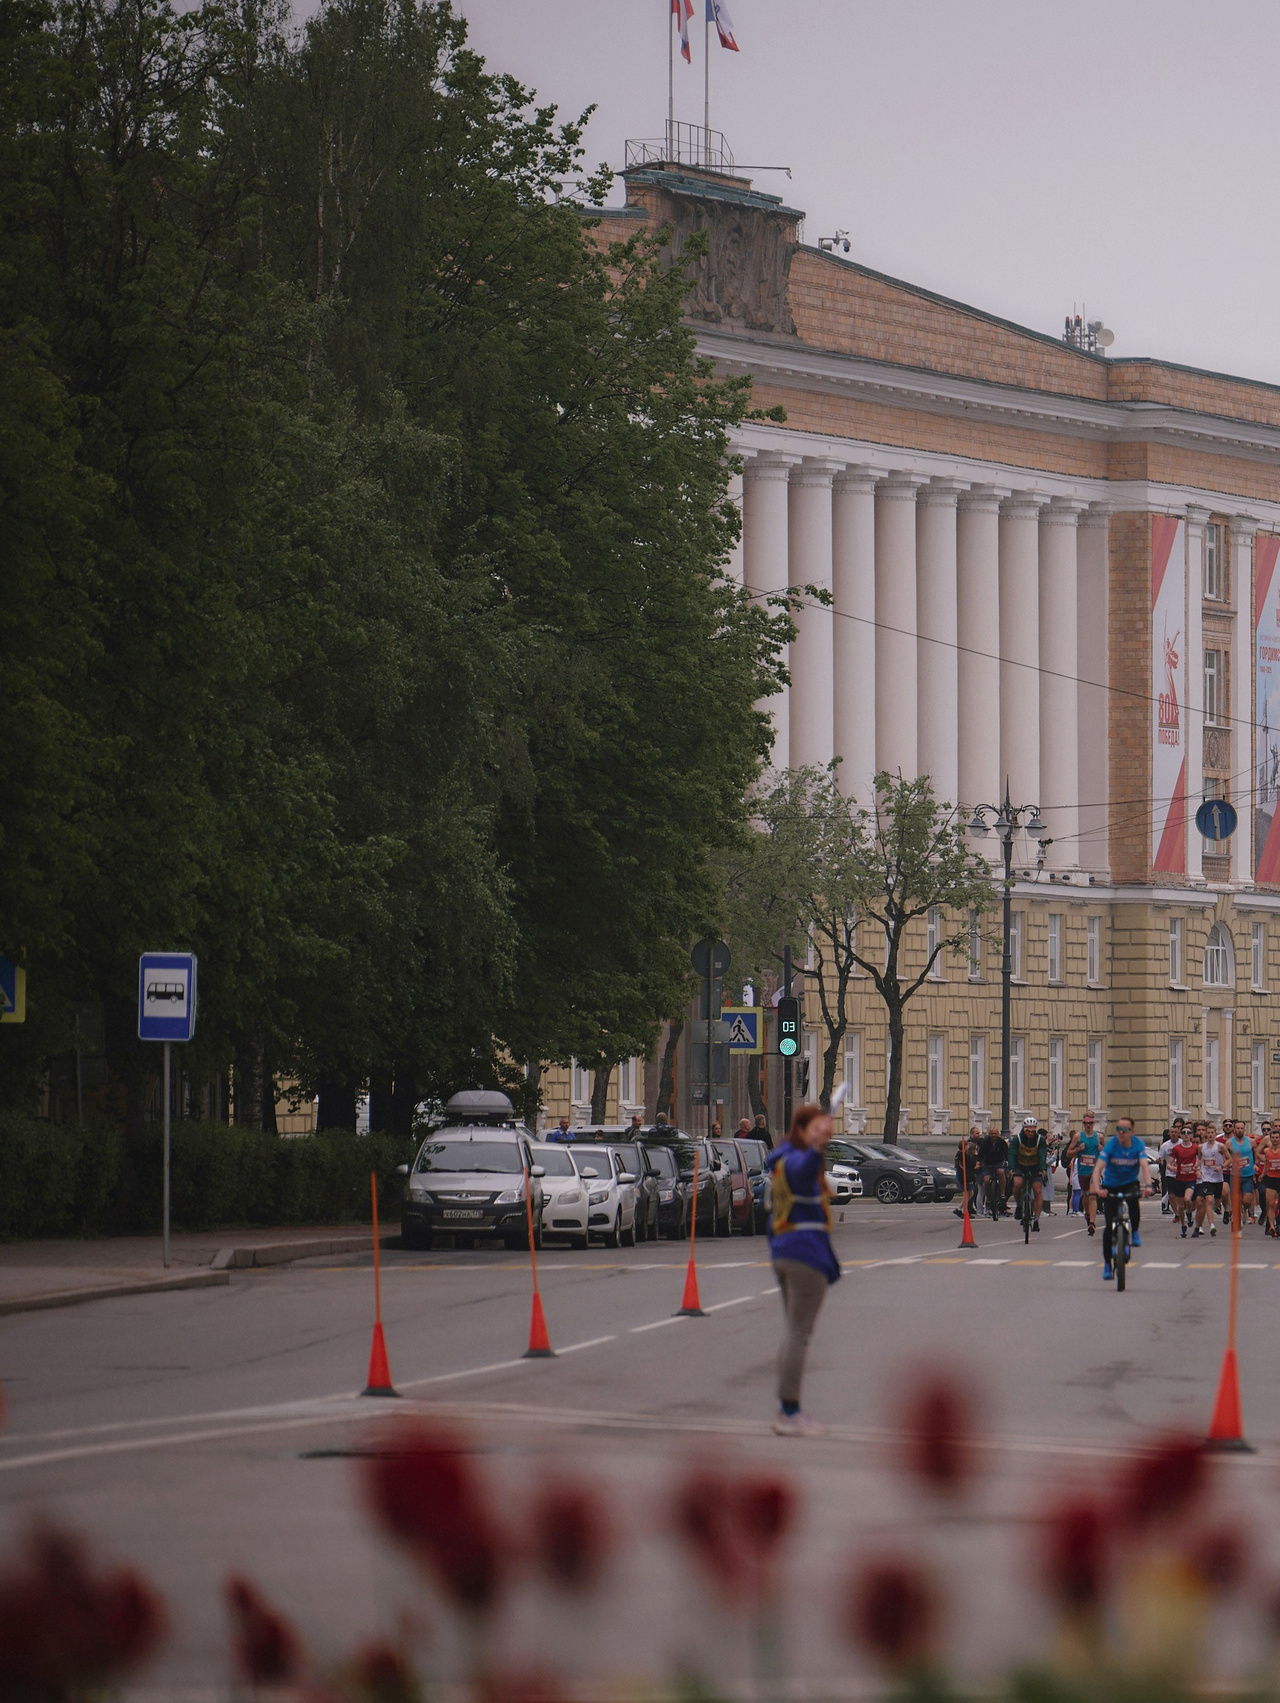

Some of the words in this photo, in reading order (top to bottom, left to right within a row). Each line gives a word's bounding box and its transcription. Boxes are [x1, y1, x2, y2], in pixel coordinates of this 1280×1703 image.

[1158, 692, 1171, 724] 80
[1158, 729, 1180, 748] ПОБЕДА!
[782, 1021, 796, 1033] 03
